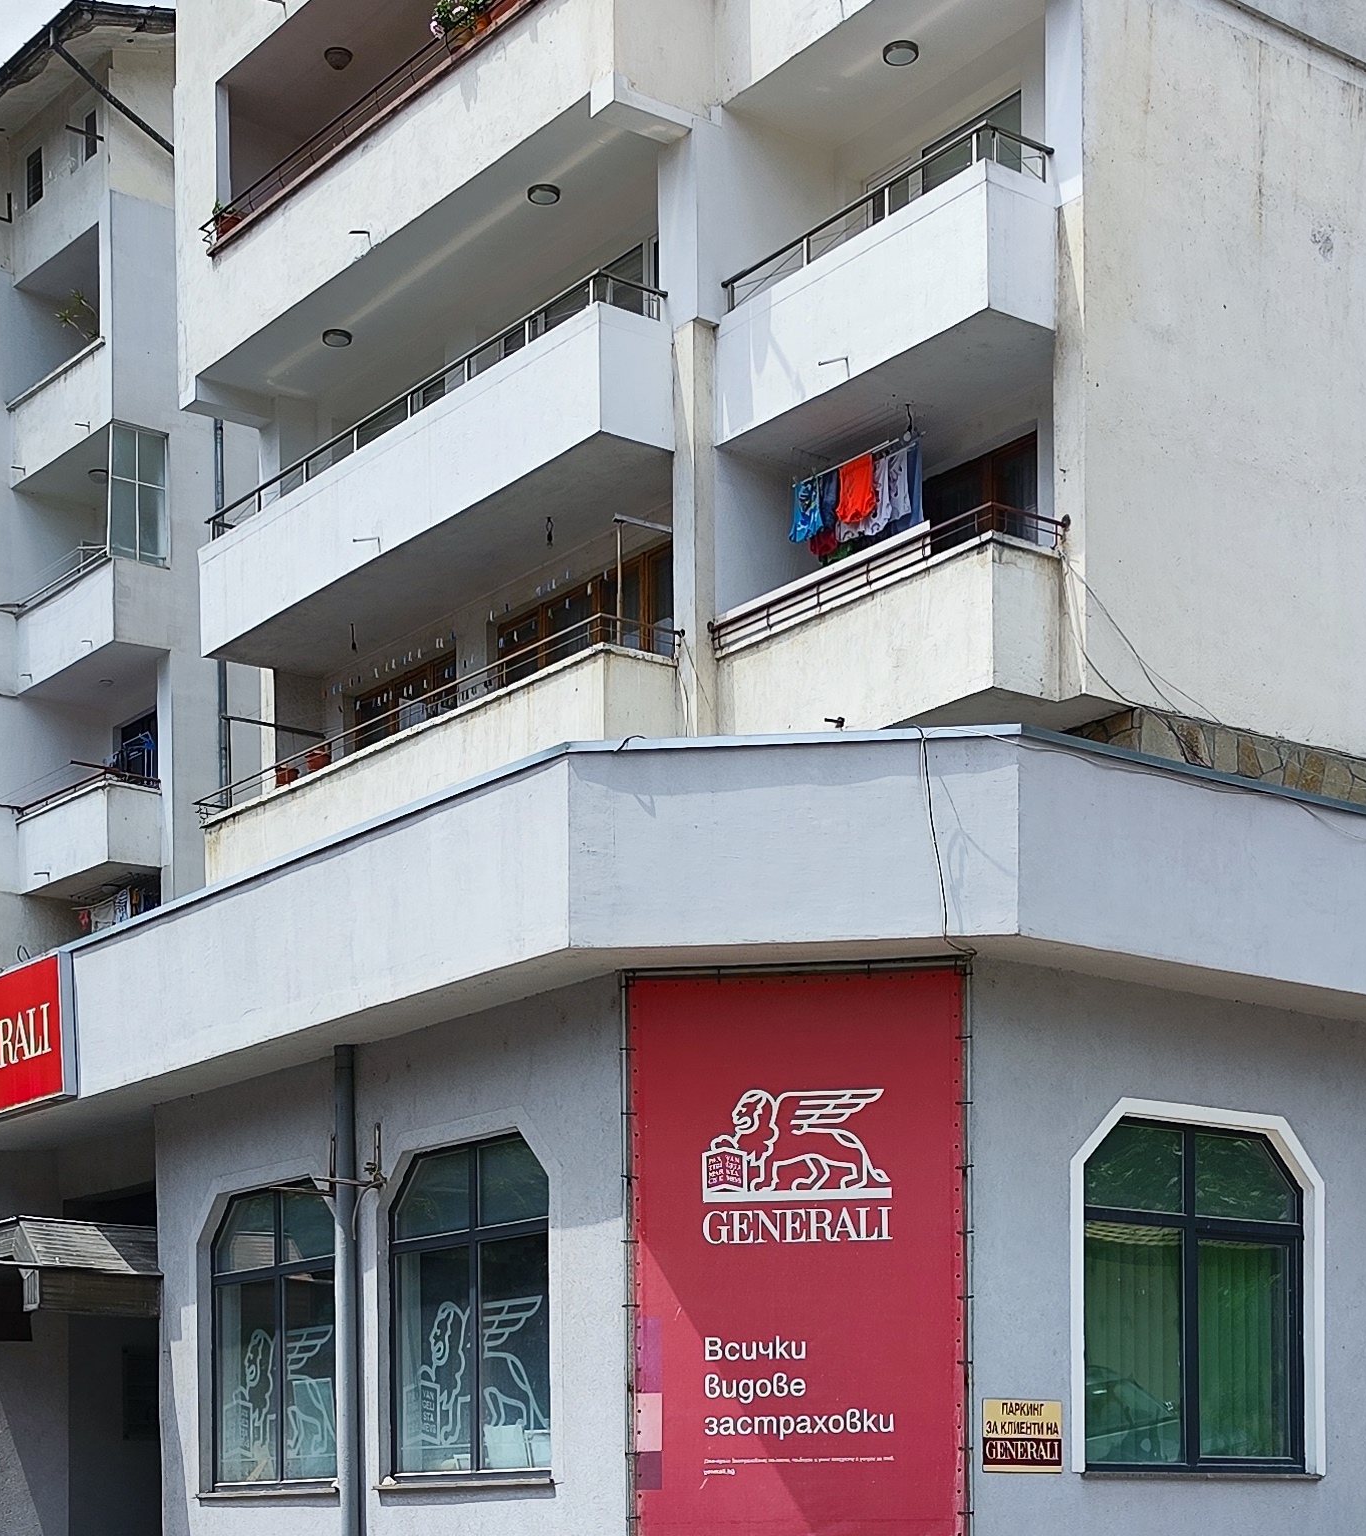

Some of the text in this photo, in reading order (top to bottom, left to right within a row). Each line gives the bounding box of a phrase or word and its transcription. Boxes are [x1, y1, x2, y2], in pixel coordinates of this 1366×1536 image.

[702, 1206, 893, 1244] GENERALI
[704, 1335, 807, 1361] Всички
[704, 1372, 807, 1404] видове
[1001, 1401, 1045, 1416] ПАРКИНГ
[704, 1408, 894, 1440] застраховки
[986, 1420, 1059, 1435] ЗА КЛИЕНТИ НА
[985, 1440, 1059, 1460] GENERALI
